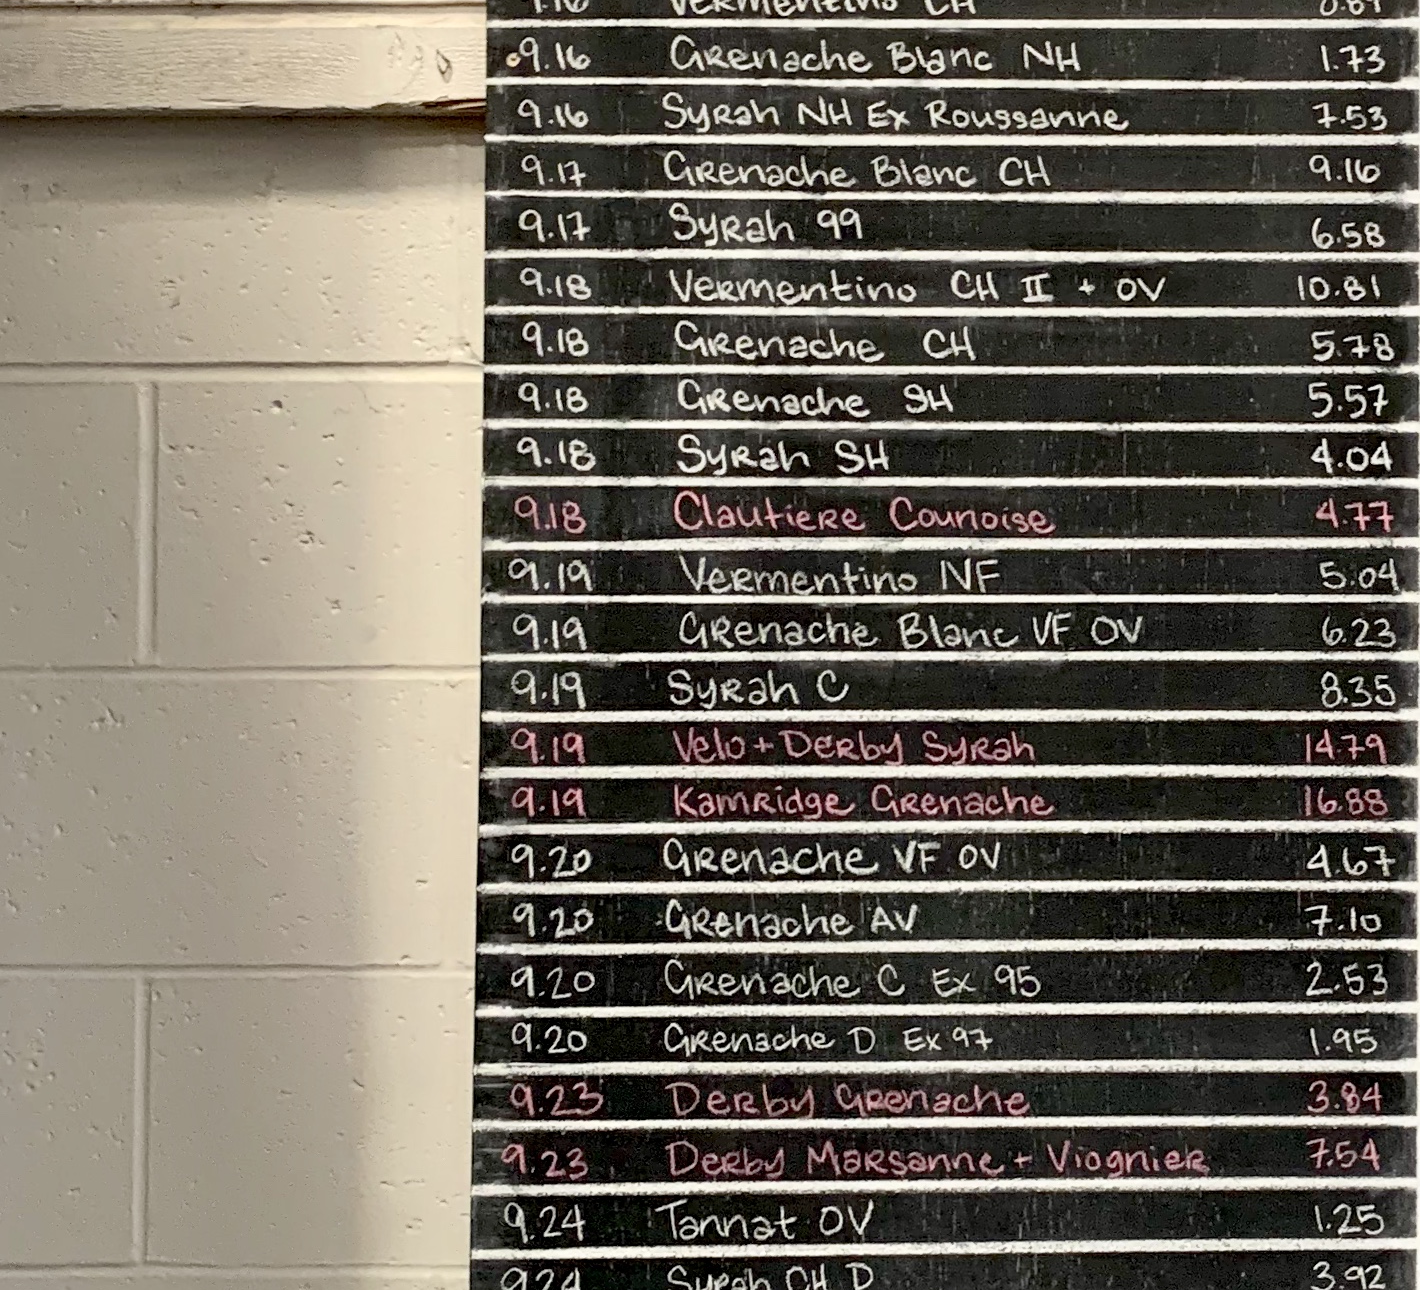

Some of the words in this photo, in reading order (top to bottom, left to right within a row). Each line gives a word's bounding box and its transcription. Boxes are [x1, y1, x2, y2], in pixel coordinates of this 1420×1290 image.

[521, 155, 586, 186] 9.17
[871, 155, 977, 187] Blanc
[999, 156, 1050, 186] CH
[1309, 155, 1380, 183] 9.16
[519, 210, 590, 242] 9.17
[817, 208, 862, 239] 99
[1312, 218, 1385, 249] 6.58
[512, 787, 586, 816] 9.19
[1306, 786, 1387, 816] 16.88
[512, 844, 591, 878] 9.20
[894, 841, 940, 873] VF
[959, 842, 1000, 869] OV
[1307, 845, 1395, 877] 4.67
[504, 1203, 585, 1243] 9.24
[655, 1199, 797, 1240] Tannat
[820, 1200, 873, 1235] OV
[1315, 1204, 1384, 1234] 1.25
